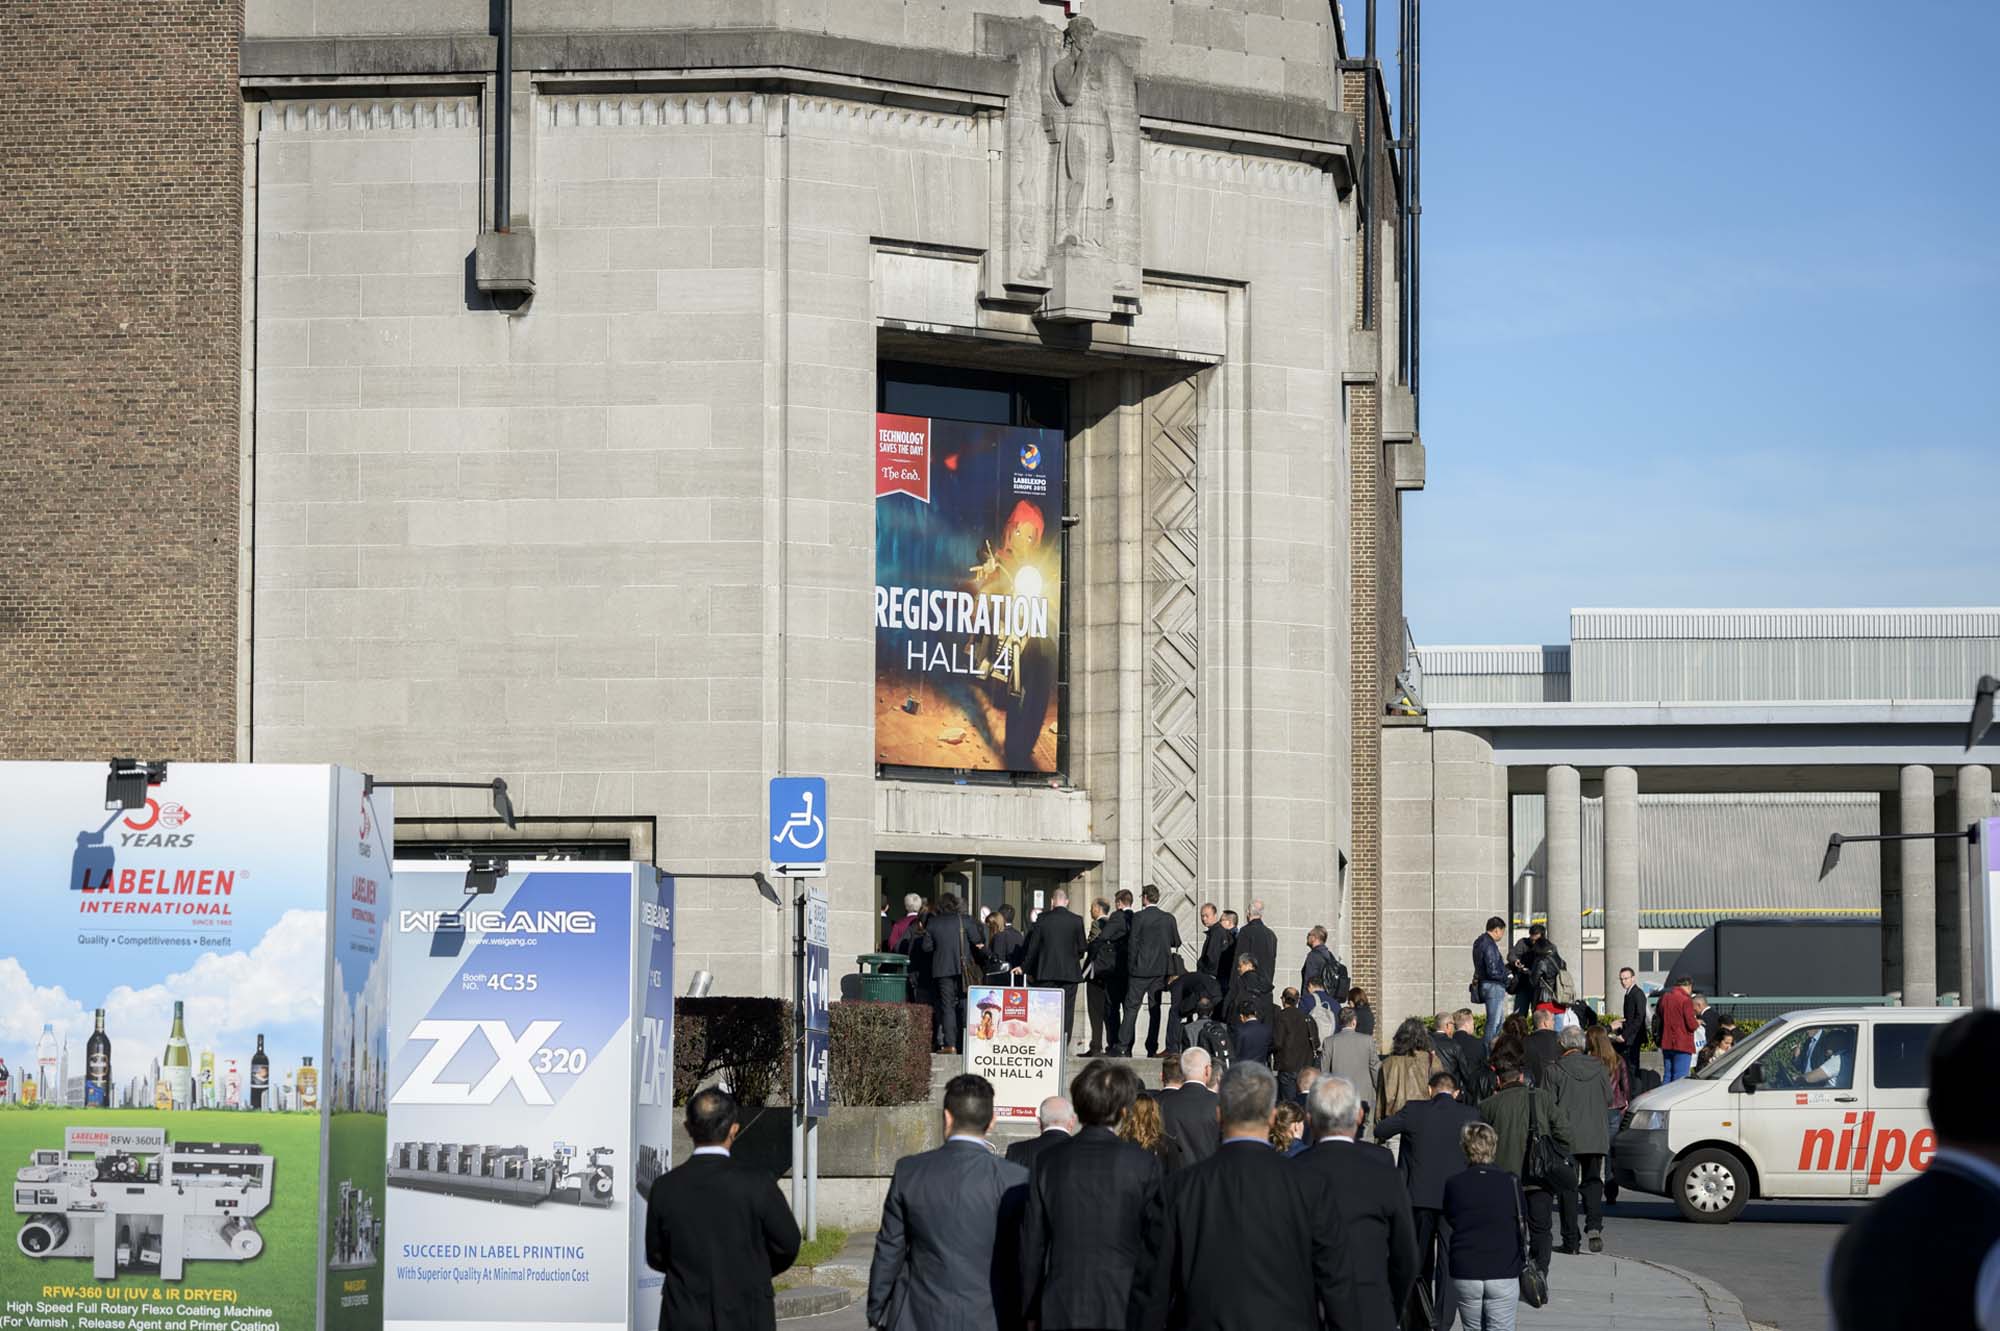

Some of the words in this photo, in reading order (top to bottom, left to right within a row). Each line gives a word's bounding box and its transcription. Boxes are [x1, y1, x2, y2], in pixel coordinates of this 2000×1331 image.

[879, 429, 925, 445] TECHNOLOGY
[880, 442, 897, 454] SAVES
[898, 444, 910, 455] THE
[881, 466, 899, 480] The
[901, 468, 920, 480] End.
[875, 586, 1048, 638] REGISTRATION
[907, 640, 985, 676] HALL
[993, 646, 1012, 676] 4
[121, 833, 194, 848] YEARS
[81, 867, 235, 896] LABELMEN
[80, 901, 232, 915] INTERNATIONAL
[400, 910, 596, 934] WEIGANG
[78, 935, 109, 947] Quality
[117, 935, 191, 948] Competitiveness
[199, 936, 231, 947] Benefit
[468, 937, 537, 947] www.weigang.cc
[463, 973, 487, 982] Booth
[487, 973, 537, 991] 4C35
[463, 982, 480, 991] NO.
[992, 1044, 1036, 1055] BADGE
[389, 1020, 563, 1105] ZX
[535, 1048, 587, 1074] 320
[974, 1055, 1053, 1067] COLLECTION
[983, 1067, 996, 1077] IN
[1000, 1068, 1032, 1079] HALL
[1036, 1070, 1043, 1079] 4
[111, 1135, 161, 1145] RFW-360UI
[403, 1244, 461, 1258] SUCCEED
[464, 1245, 477, 1258] IN
[480, 1245, 520, 1258] LABEL
[523, 1246, 584, 1259] PRINTING
[397, 1266, 416, 1280] With
[417, 1267, 451, 1283] Superior
[453, 1267, 482, 1284] Quality
[483, 1268, 492, 1281] At
[494, 1267, 525, 1281] Minimal
[527, 1268, 571, 1282] Production
[572, 1269, 589, 1282] Cost
[43, 1285, 102, 1298] RFW-360
[106, 1287, 120, 1299] UI
[124, 1287, 148, 1301] (UV
[152, 1288, 162, 1300] &
[166, 1289, 180, 1300] IR
[184, 1289, 238, 1304] DRYER)
[7, 1301, 33, 1315] High
[36, 1301, 73, 1315] Speed
[76, 1302, 97, 1313] Full
[101, 1303, 138, 1316] Rotary
[142, 1304, 173, 1315] Flexo
[176, 1304, 221, 1319] Coating
[224, 1305, 272, 1317] Machine
[0, 1316, 22, 1329] (For
[26, 1316, 68, 1328] Varnish
[79, 1317, 125, 1329] Release
[128, 1318, 162, 1331] Agent
[165, 1319, 186, 1330] and
[190, 1320, 228, 1331] Primer
[231, 1320, 280, 1331] Coating)
